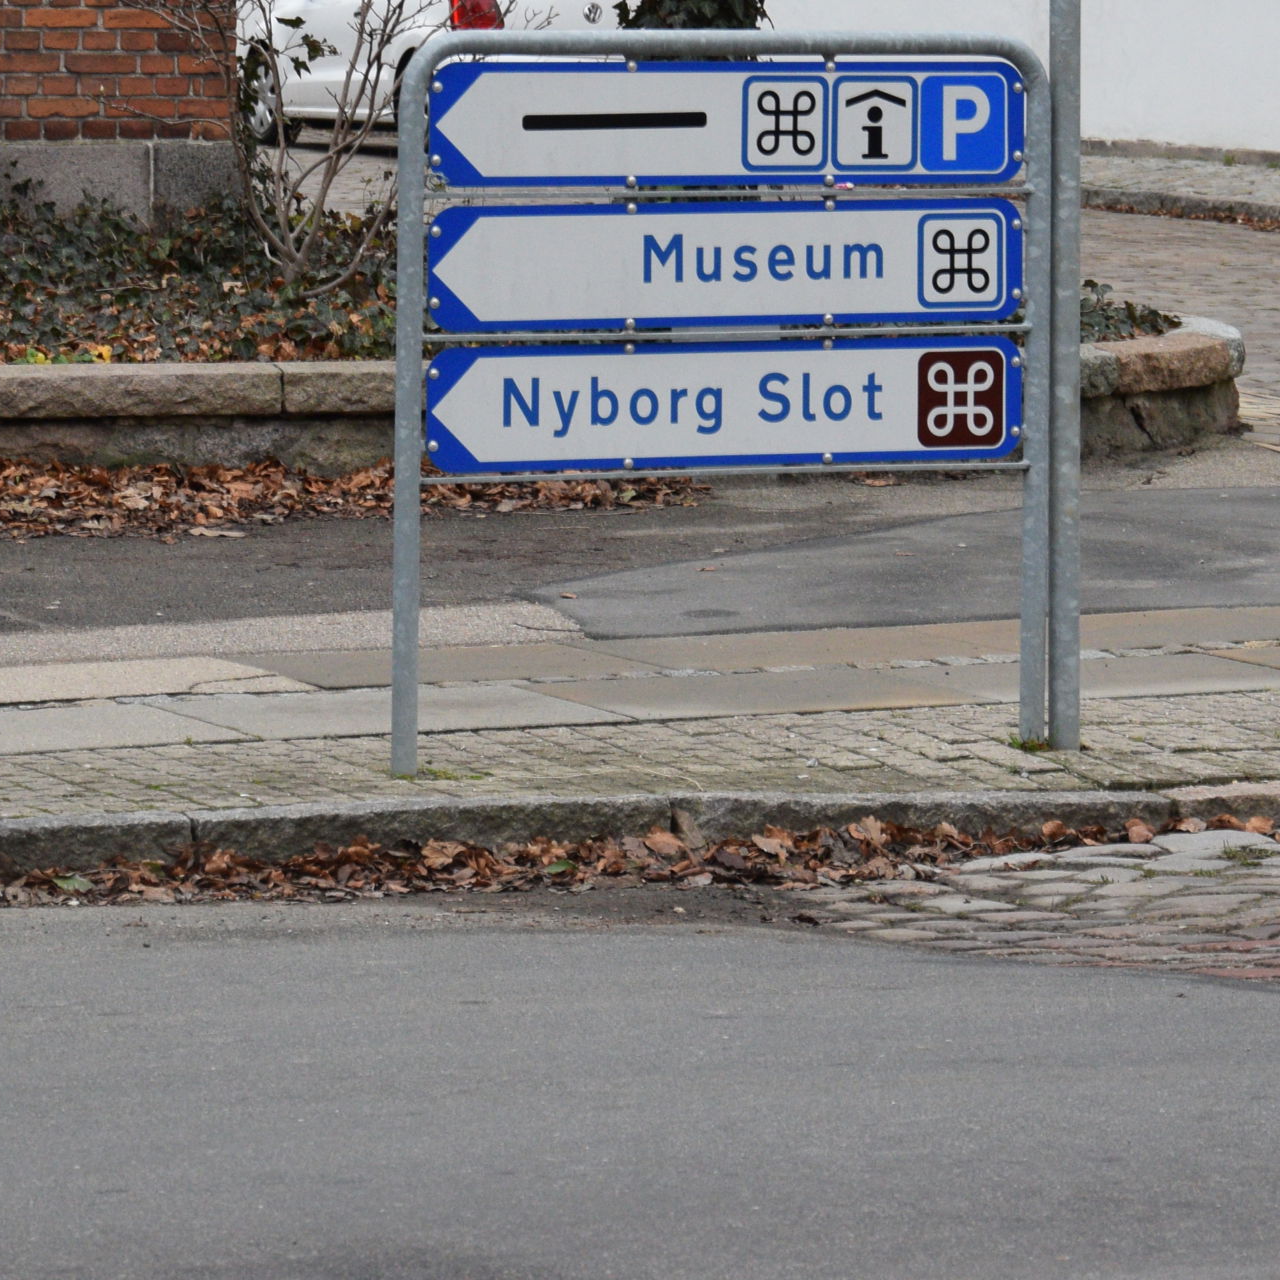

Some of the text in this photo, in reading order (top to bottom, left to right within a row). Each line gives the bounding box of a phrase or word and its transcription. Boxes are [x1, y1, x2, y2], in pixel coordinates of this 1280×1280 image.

[942, 85, 991, 161] P
[642, 234, 884, 283] Museum
[502, 372, 883, 437] Nyborg Slot
